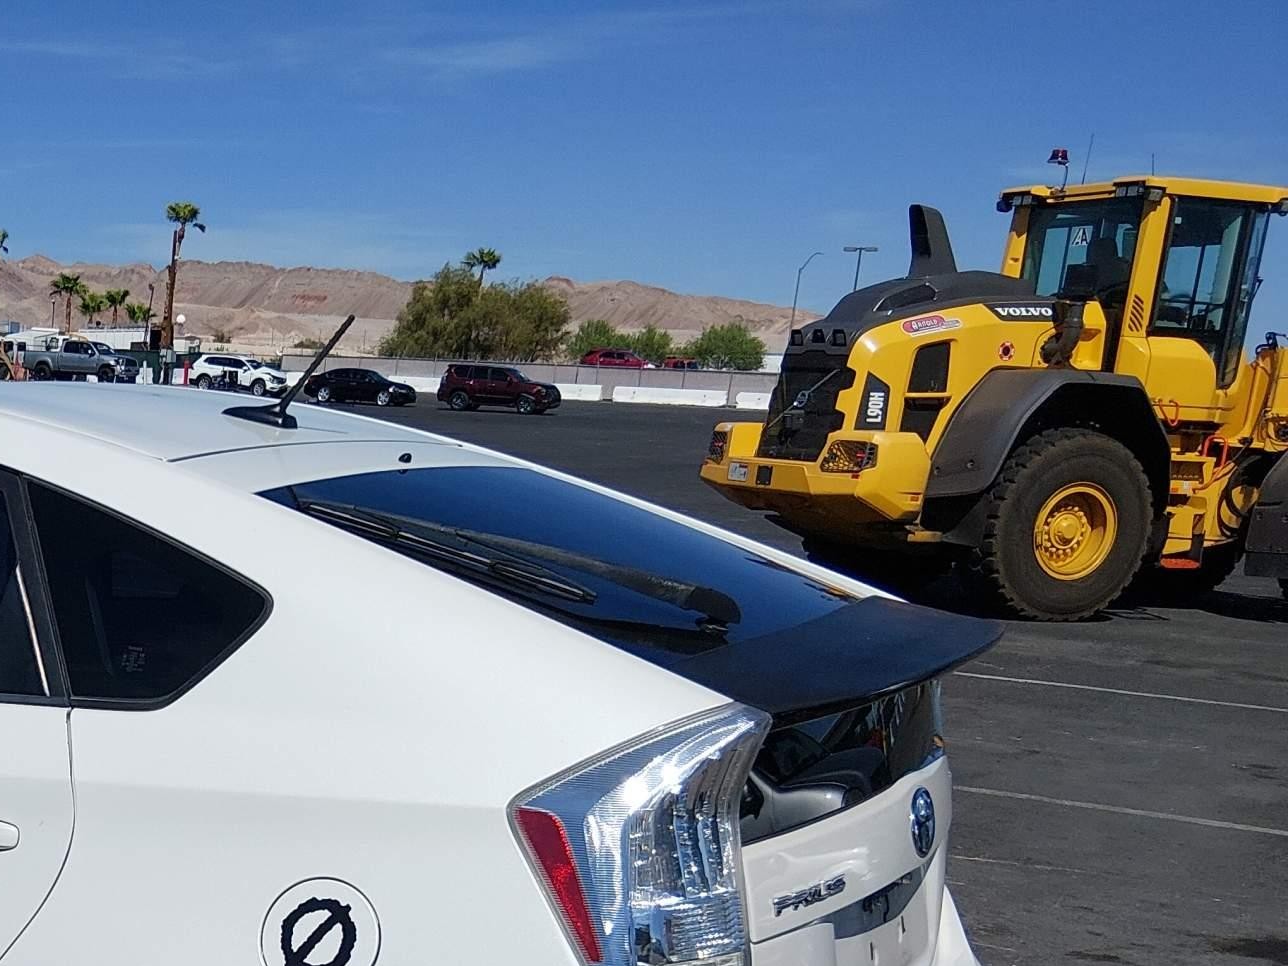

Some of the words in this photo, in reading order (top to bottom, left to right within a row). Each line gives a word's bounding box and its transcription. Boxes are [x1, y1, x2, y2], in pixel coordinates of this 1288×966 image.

[994, 307, 1053, 317] VOLVO
[866, 391, 885, 423] L90H
[773, 873, 847, 917] PRIUS
